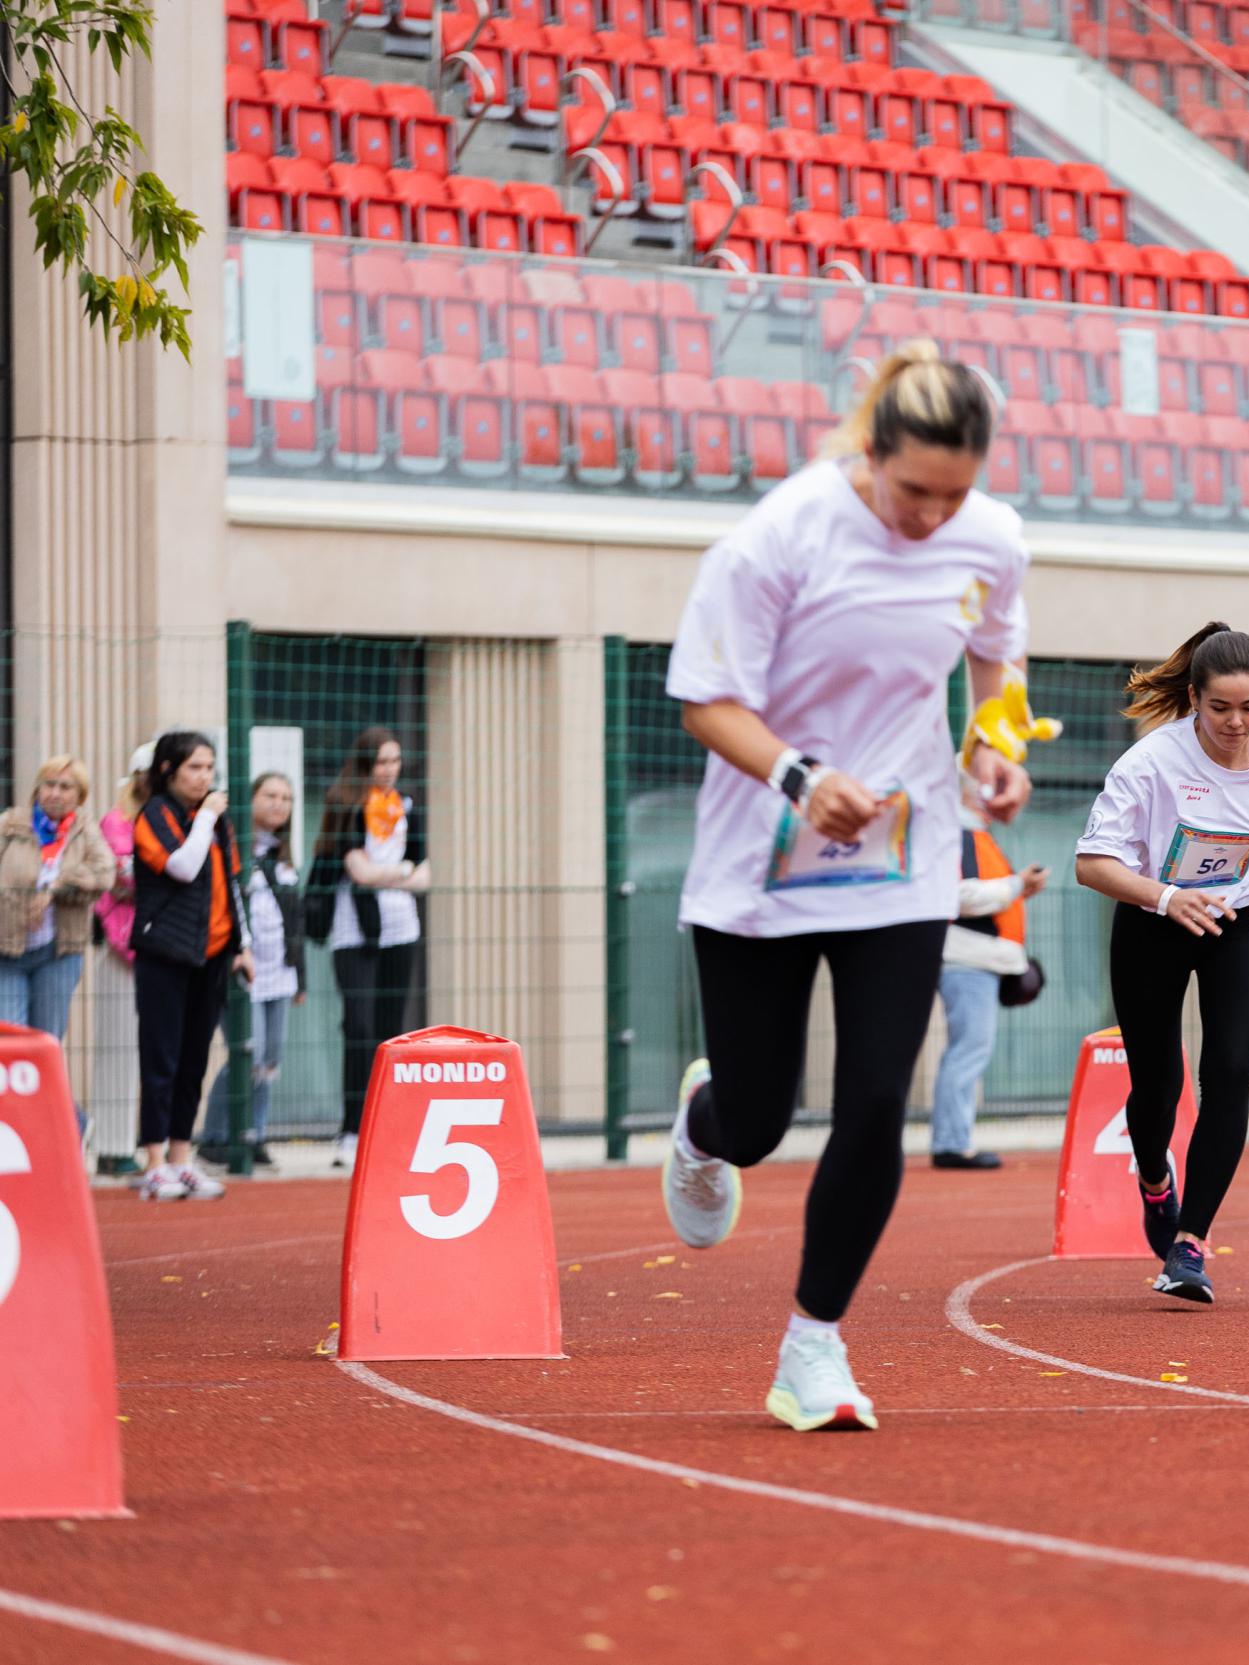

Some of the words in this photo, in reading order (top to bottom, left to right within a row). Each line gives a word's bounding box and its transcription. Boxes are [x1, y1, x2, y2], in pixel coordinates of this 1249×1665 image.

[1196, 859, 1228, 875] 50
[393, 1061, 507, 1084] MONDO
[400, 1098, 505, 1240] 5
